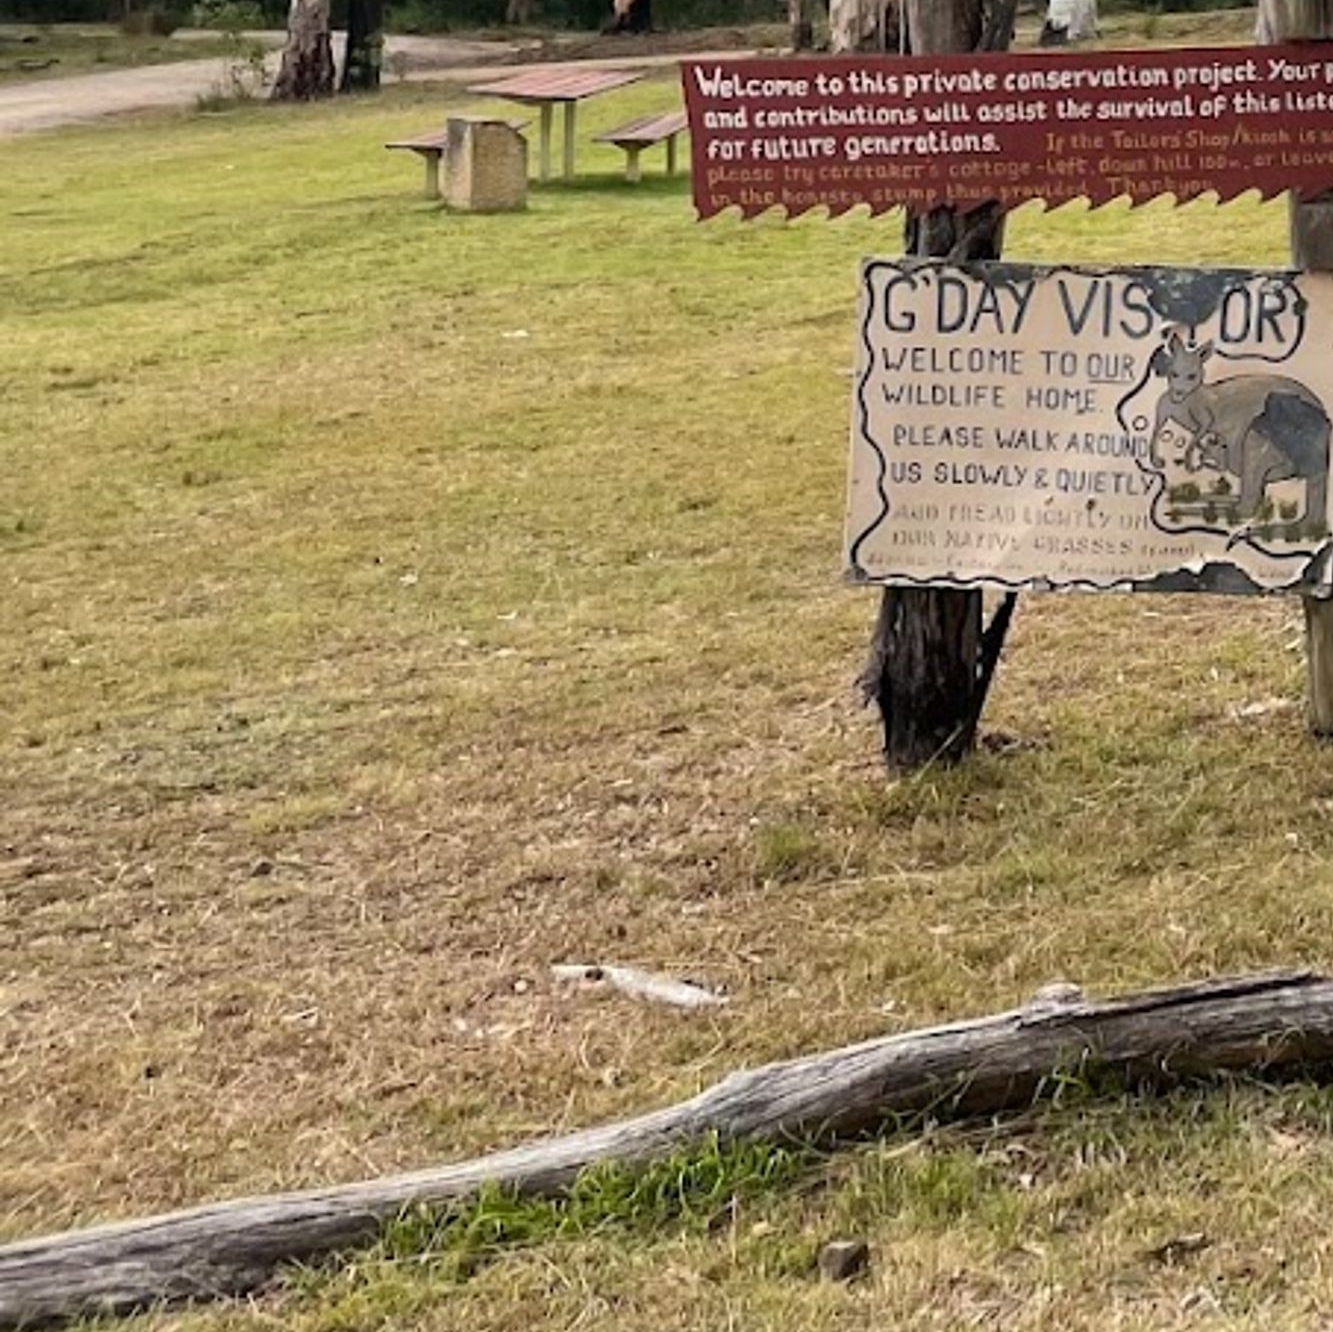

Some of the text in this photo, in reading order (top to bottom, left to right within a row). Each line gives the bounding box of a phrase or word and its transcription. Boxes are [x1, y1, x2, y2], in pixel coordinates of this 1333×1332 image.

[695, 66, 808, 98] Welcome
[815, 73, 843, 95] to
[848, 70, 898, 94] this
[904, 69, 997, 98] private
[1004, 65, 1169, 91] conservation
[1173, 61, 1263, 92] project.
[1268, 59, 1321, 81] Your
[704, 106, 748, 128] and
[754, 104, 917, 128] contributions
[923, 103, 971, 122] will
[977, 100, 1046, 122] assist
[1056, 98, 1092, 119] the
[1097, 95, 1194, 118] survival
[1200, 95, 1227, 118] of
[1233, 89, 1280, 113] this
[707, 130, 1000, 160] for future generations.
[1046, 132, 1065, 153] If
[1070, 132, 1103, 148] the
[1300, 127, 1315, 143] is
[708, 165, 774, 187] please
[784, 165, 814, 186] try
[951, 160, 1030, 181] cottage
[1154, 153, 1192, 171] hill
[1254, 154, 1273, 167] or
[740, 187, 774, 205] the
[873, 185, 937, 202] stump
[884, 276, 1035, 334] G'DAY
[881, 347, 1135, 381] WELCOME TO OUR
[881, 383, 1006, 408] WILDLIFE
[893, 424, 1149, 458] PLEASE WALK AROUND
[890, 462, 1154, 496] US SLOWLY & QUIETLY
